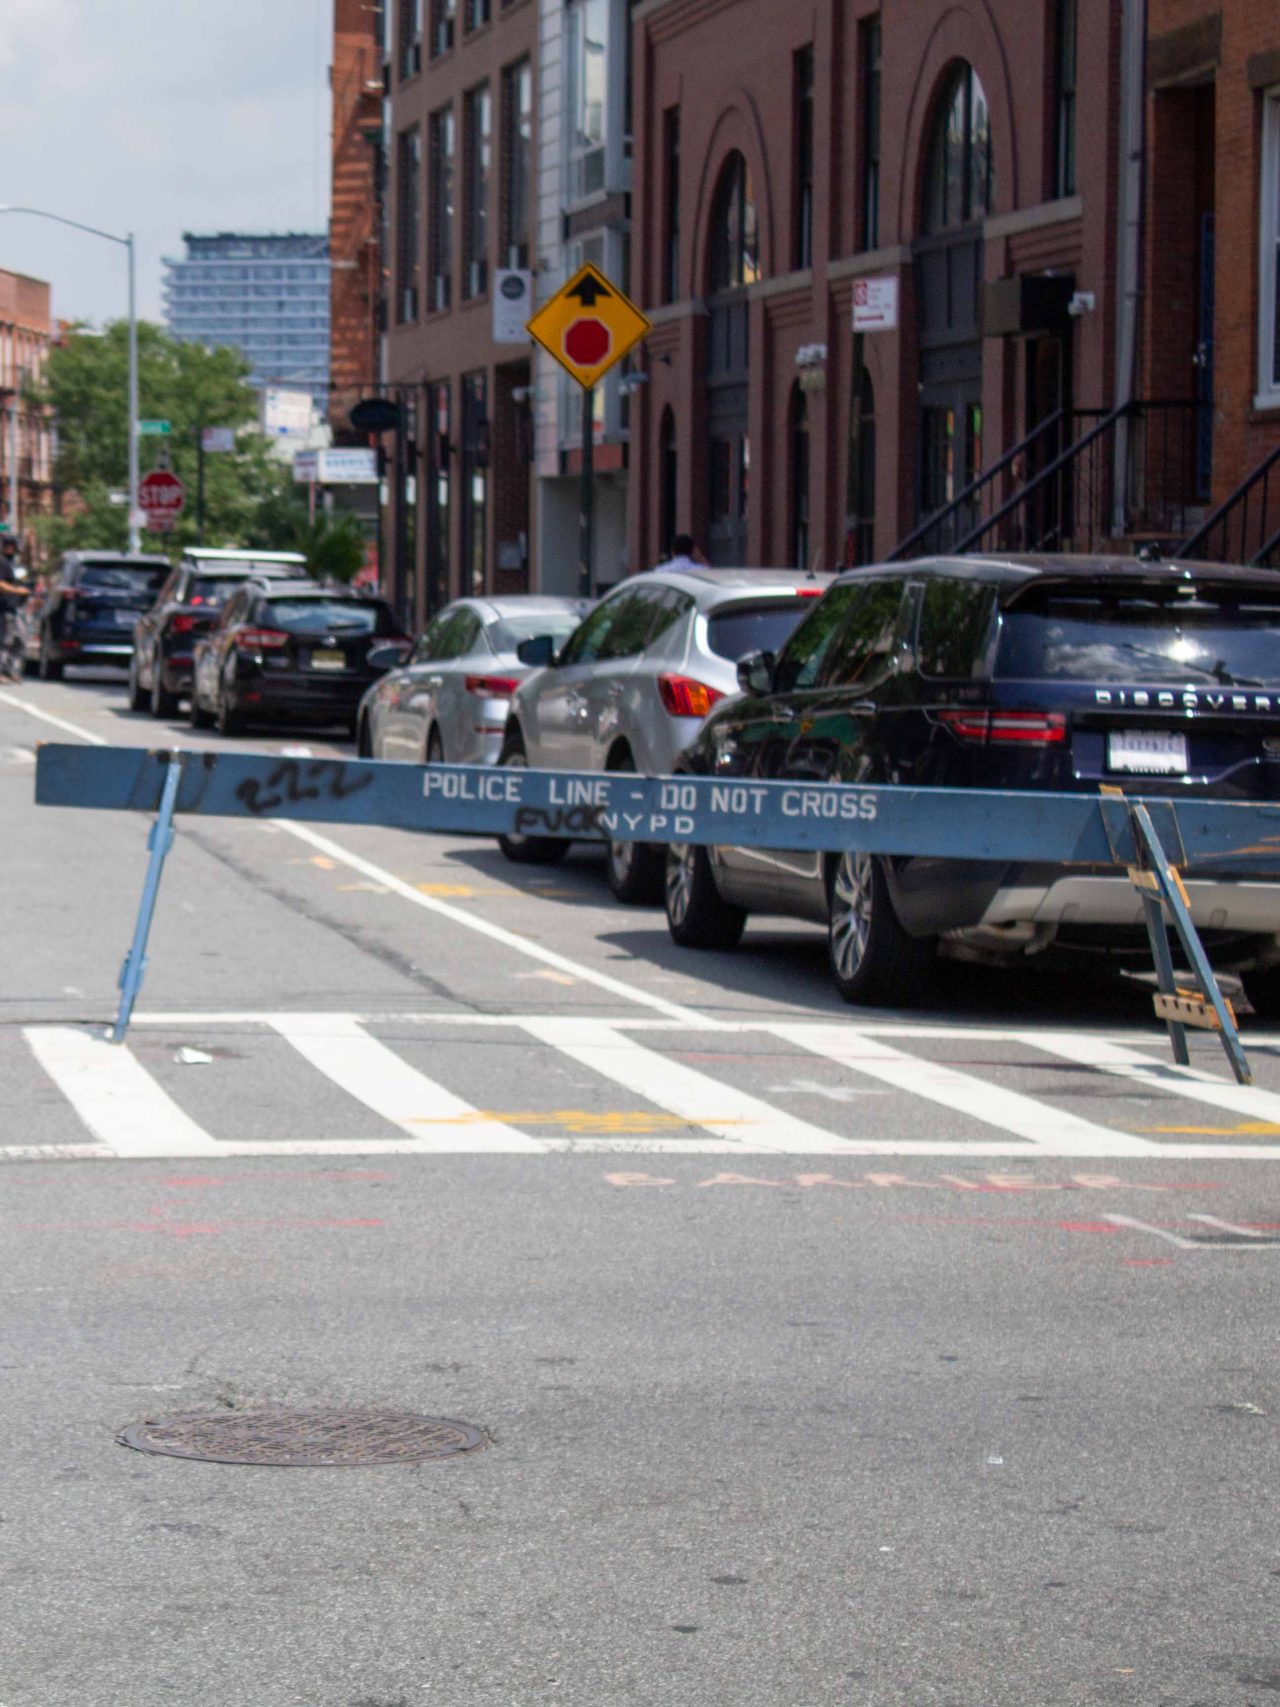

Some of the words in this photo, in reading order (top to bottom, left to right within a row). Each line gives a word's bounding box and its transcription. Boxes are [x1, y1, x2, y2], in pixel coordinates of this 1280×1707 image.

[140, 485, 181, 504] STOP
[1095, 690, 1280, 712] DISCOVER
[423, 771, 523, 801] POLICE
[549, 779, 611, 806] LINE
[661, 784, 696, 811] DO
[711, 787, 768, 814] NOT
[781, 790, 878, 820] CROSS
[598, 813, 694, 834] NYPD
